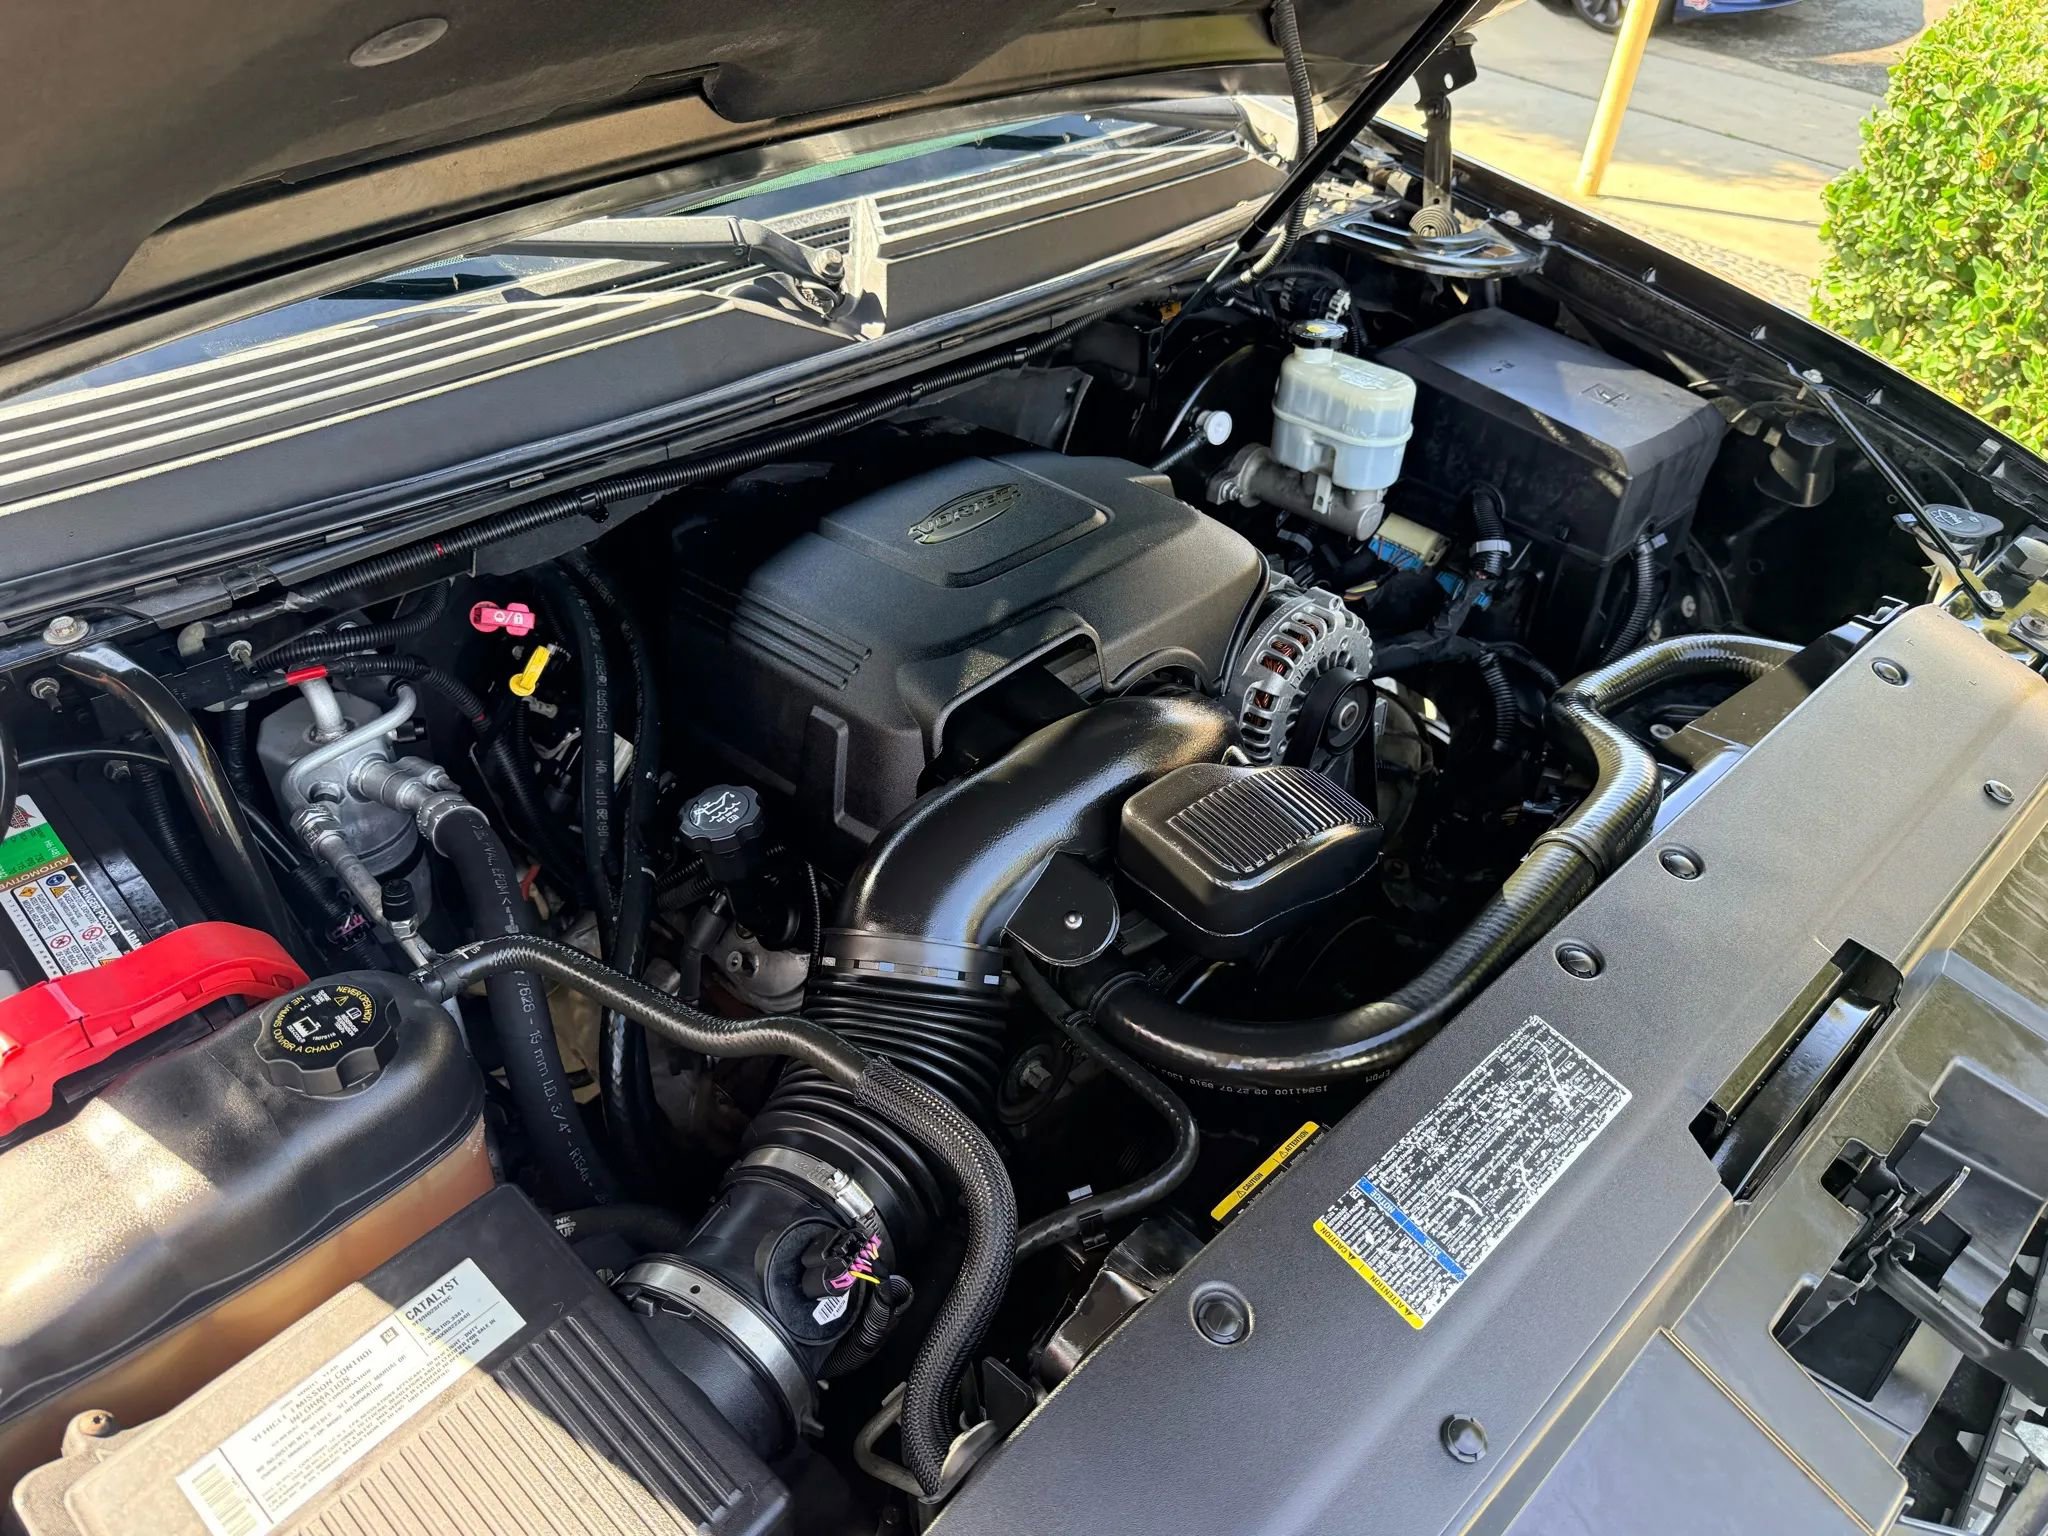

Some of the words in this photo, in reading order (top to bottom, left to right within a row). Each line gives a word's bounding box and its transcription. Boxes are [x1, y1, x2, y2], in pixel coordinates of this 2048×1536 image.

[0, 857, 69, 890] AUTOMOTIVE
[77, 882, 101, 912] DANGER
[95, 908, 118, 936] POISON
[291, 995, 305, 1005] NE
[335, 985, 361, 997] NEVER
[359, 993, 371, 1008] OPEN
[273, 1004, 292, 1027] JAMAIS
[273, 1029, 296, 1051] OUVRIR
[304, 1039, 343, 1053] CHAUD!
[532, 1048, 551, 1077] mm
[1241, 1171, 1264, 1192] CAUTION
[1283, 1128, 1310, 1153] ATTENTION
[1368, 1187, 1396, 1214] NOTICE
[1321, 1226, 1350, 1256] CAUTION
[1422, 1237, 1442, 1256] AVIS
[404, 1274, 461, 1322] CATALYST
[1368, 1274, 1406, 1309] ATTENTION
[288, 1374, 351, 1424] INFORMATION
